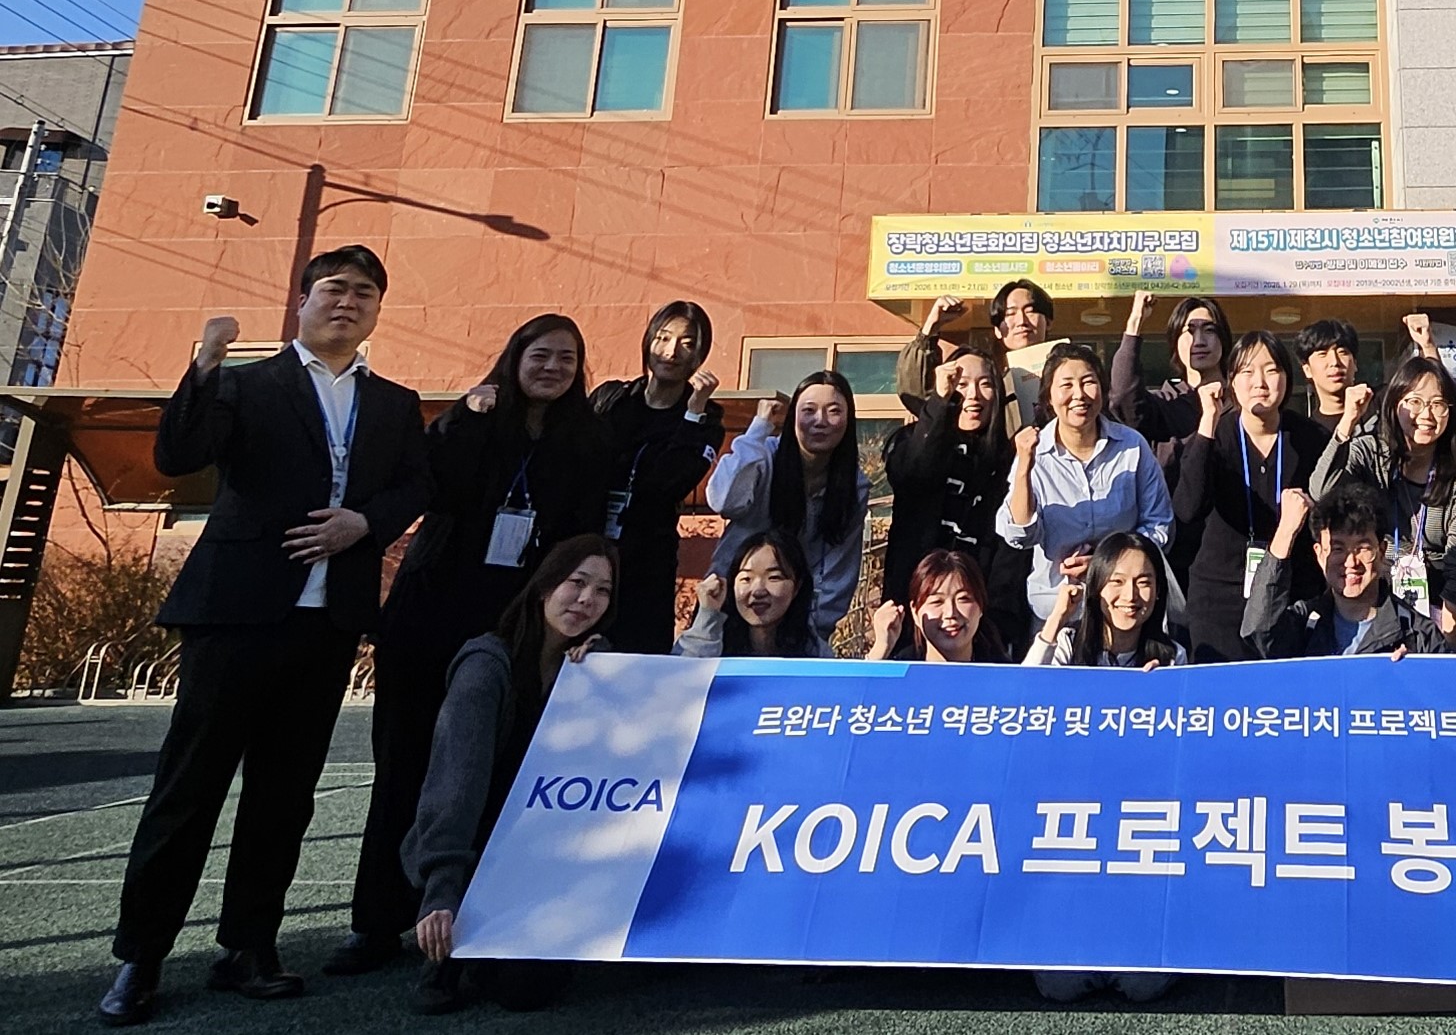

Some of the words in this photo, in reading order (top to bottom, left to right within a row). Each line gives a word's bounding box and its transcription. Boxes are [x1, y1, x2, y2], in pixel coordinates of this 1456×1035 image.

[887, 232, 1039, 255] 장락청소년문화의집
[1042, 230, 1162, 253] 청소년자치기구
[1163, 230, 1199, 252] 모집
[1230, 229, 1287, 251] 제15기
[1288, 227, 1340, 250] 제천시
[752, 704, 842, 737] 르완다
[847, 704, 936, 737] 청소년
[940, 704, 1057, 737] 역량강화
[1063, 705, 1091, 737] 및
[1098, 705, 1216, 738] 지역사회
[1223, 706, 1341, 739] 아웃리치
[525, 775, 664, 812] KOICA
[729, 802, 1000, 875] KOICA
[1022, 797, 1356, 887] 프로젝트
